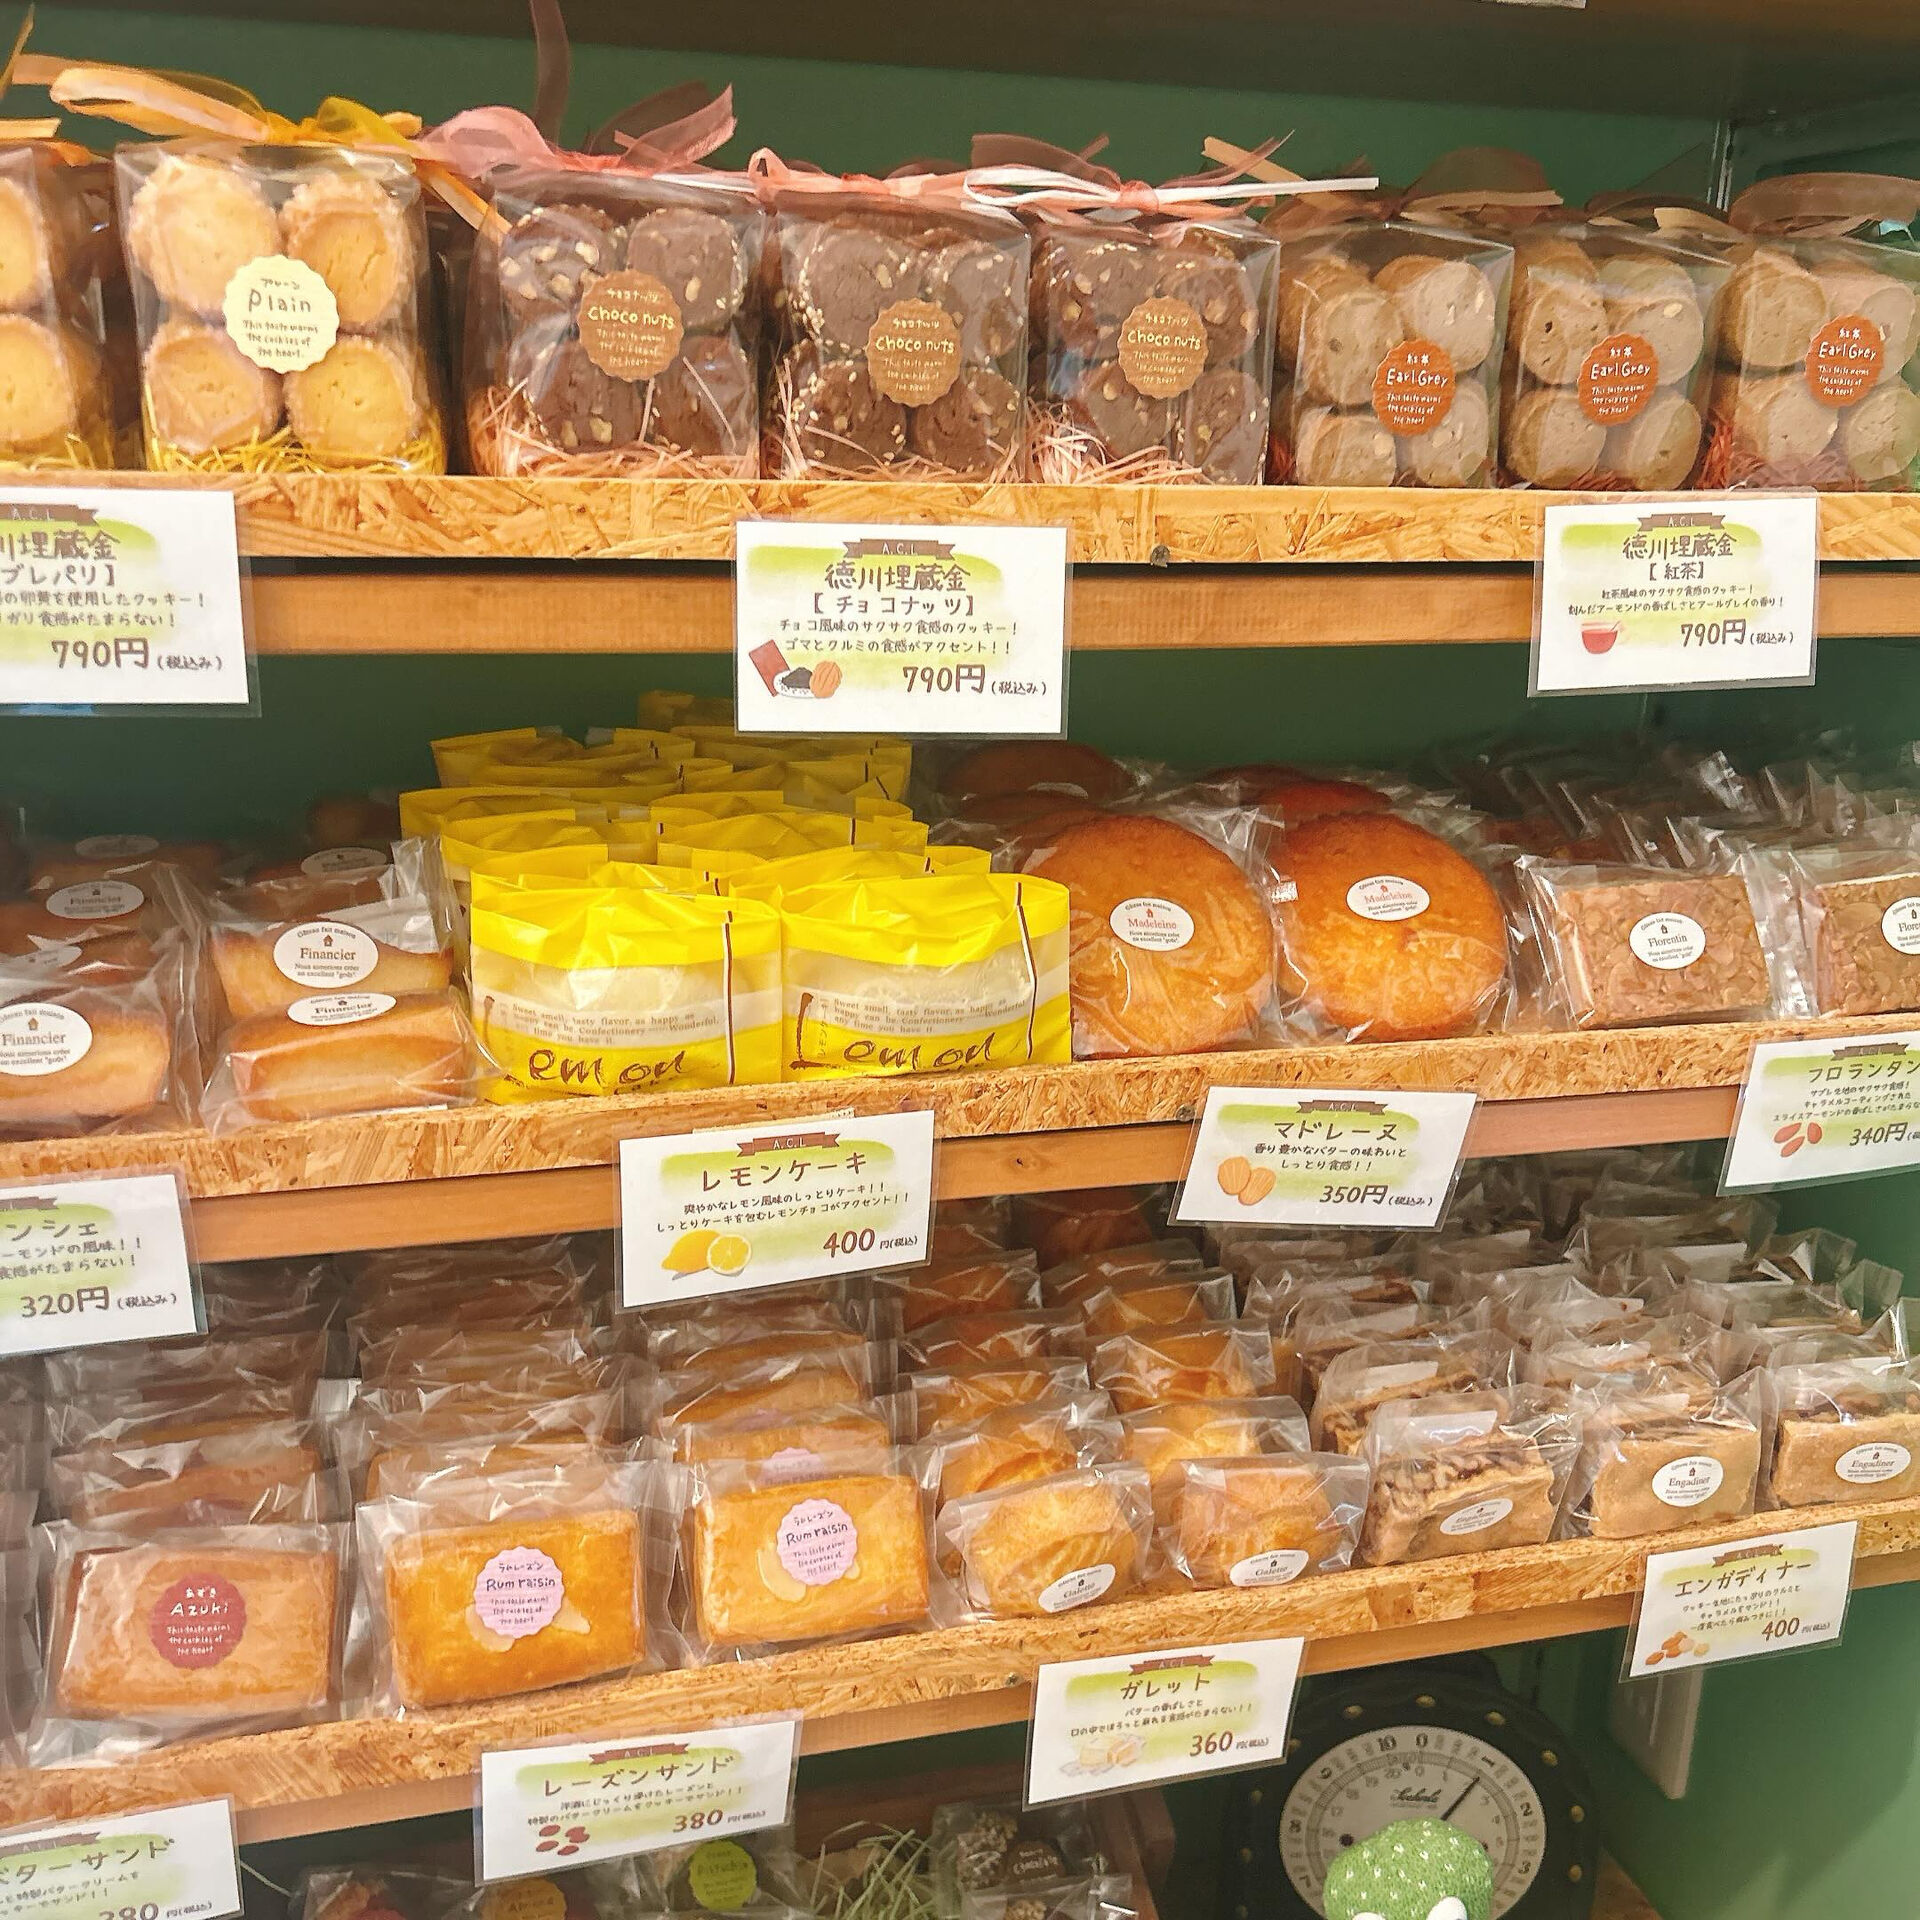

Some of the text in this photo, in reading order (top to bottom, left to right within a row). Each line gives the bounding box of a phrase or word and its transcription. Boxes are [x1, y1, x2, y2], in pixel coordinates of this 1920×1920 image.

[248, 288, 311, 312] Plain
[587, 306, 675, 330] Choco nuts
[875, 336, 954, 353] Choco nuts
[1128, 330, 1201, 350] Choco nuts
[1819, 341, 1876, 360] Earl Grey
[1387, 368, 1448, 388] Earl Grey
[1590, 361, 1651, 380] Earl Grey
[1622, 533, 1737, 560] 徳川埋蔵金
[824, 560, 971, 591] 徳川埋蔵金
[1649, 561, 1704, 581] 【紅茶】
[1601, 584, 1753, 600] 紅茶風味のサクサク食感のクッキー！
[813, 592, 973, 615] 【チョコナッツ】
[780, 619, 1017, 635] チョコ風味のサクサク食感のクッキー！
[1681, 619, 1746, 647] 790円
[51, 638, 149, 669] 790円
[785, 639, 1011, 654] ゴマとクルミの食感がアクセント！！
[903, 664, 986, 693] 790円
[1648, 933, 1687, 947] Florentin
[300, 947, 356, 960] Financier
[2, 1031, 66, 1046] Financier
[1809, 1061, 1920, 1083] フロランタン
[1274, 1120, 1397, 1142] マドレーヌ
[1850, 1122, 1908, 1147] 340円
[1255, 1143, 1407, 1158] 香り豊かなバターの味わいと
[702, 1152, 867, 1192] レモンケーキ
[1281, 1159, 1373, 1172] しっとり食感！！
[684, 1182, 885, 1215] 爽やかなレモン風味のしっとりケーキ！！
[1319, 1185, 1388, 1206] 350円
[657, 1193, 909, 1233] しっとりケーキを包むレモンチョコがアクセント！！
[6, 1219, 99, 1241] ンシェ
[823, 1229, 875, 1258] 400
[20, 1286, 110, 1318] 320円
[786, 1523, 848, 1547] Rum raisin
[486, 1577, 555, 1592] Rum raisin
[1674, 1560, 1811, 1597] エンガディナー
[170, 1602, 229, 1617] Azuki
[1762, 1617, 1800, 1642] 400
[1121, 1672, 1210, 1700] ガレット
[1125, 1700, 1203, 1717] バターの香ばしさと
[1190, 1731, 1233, 1757] 360
[1377, 1734, 1397, 1751] 10
[1415, 1732, 1428, 1748] 0
[545, 1756, 734, 1797] レーズンサンド
[672, 1809, 723, 1833] 380
